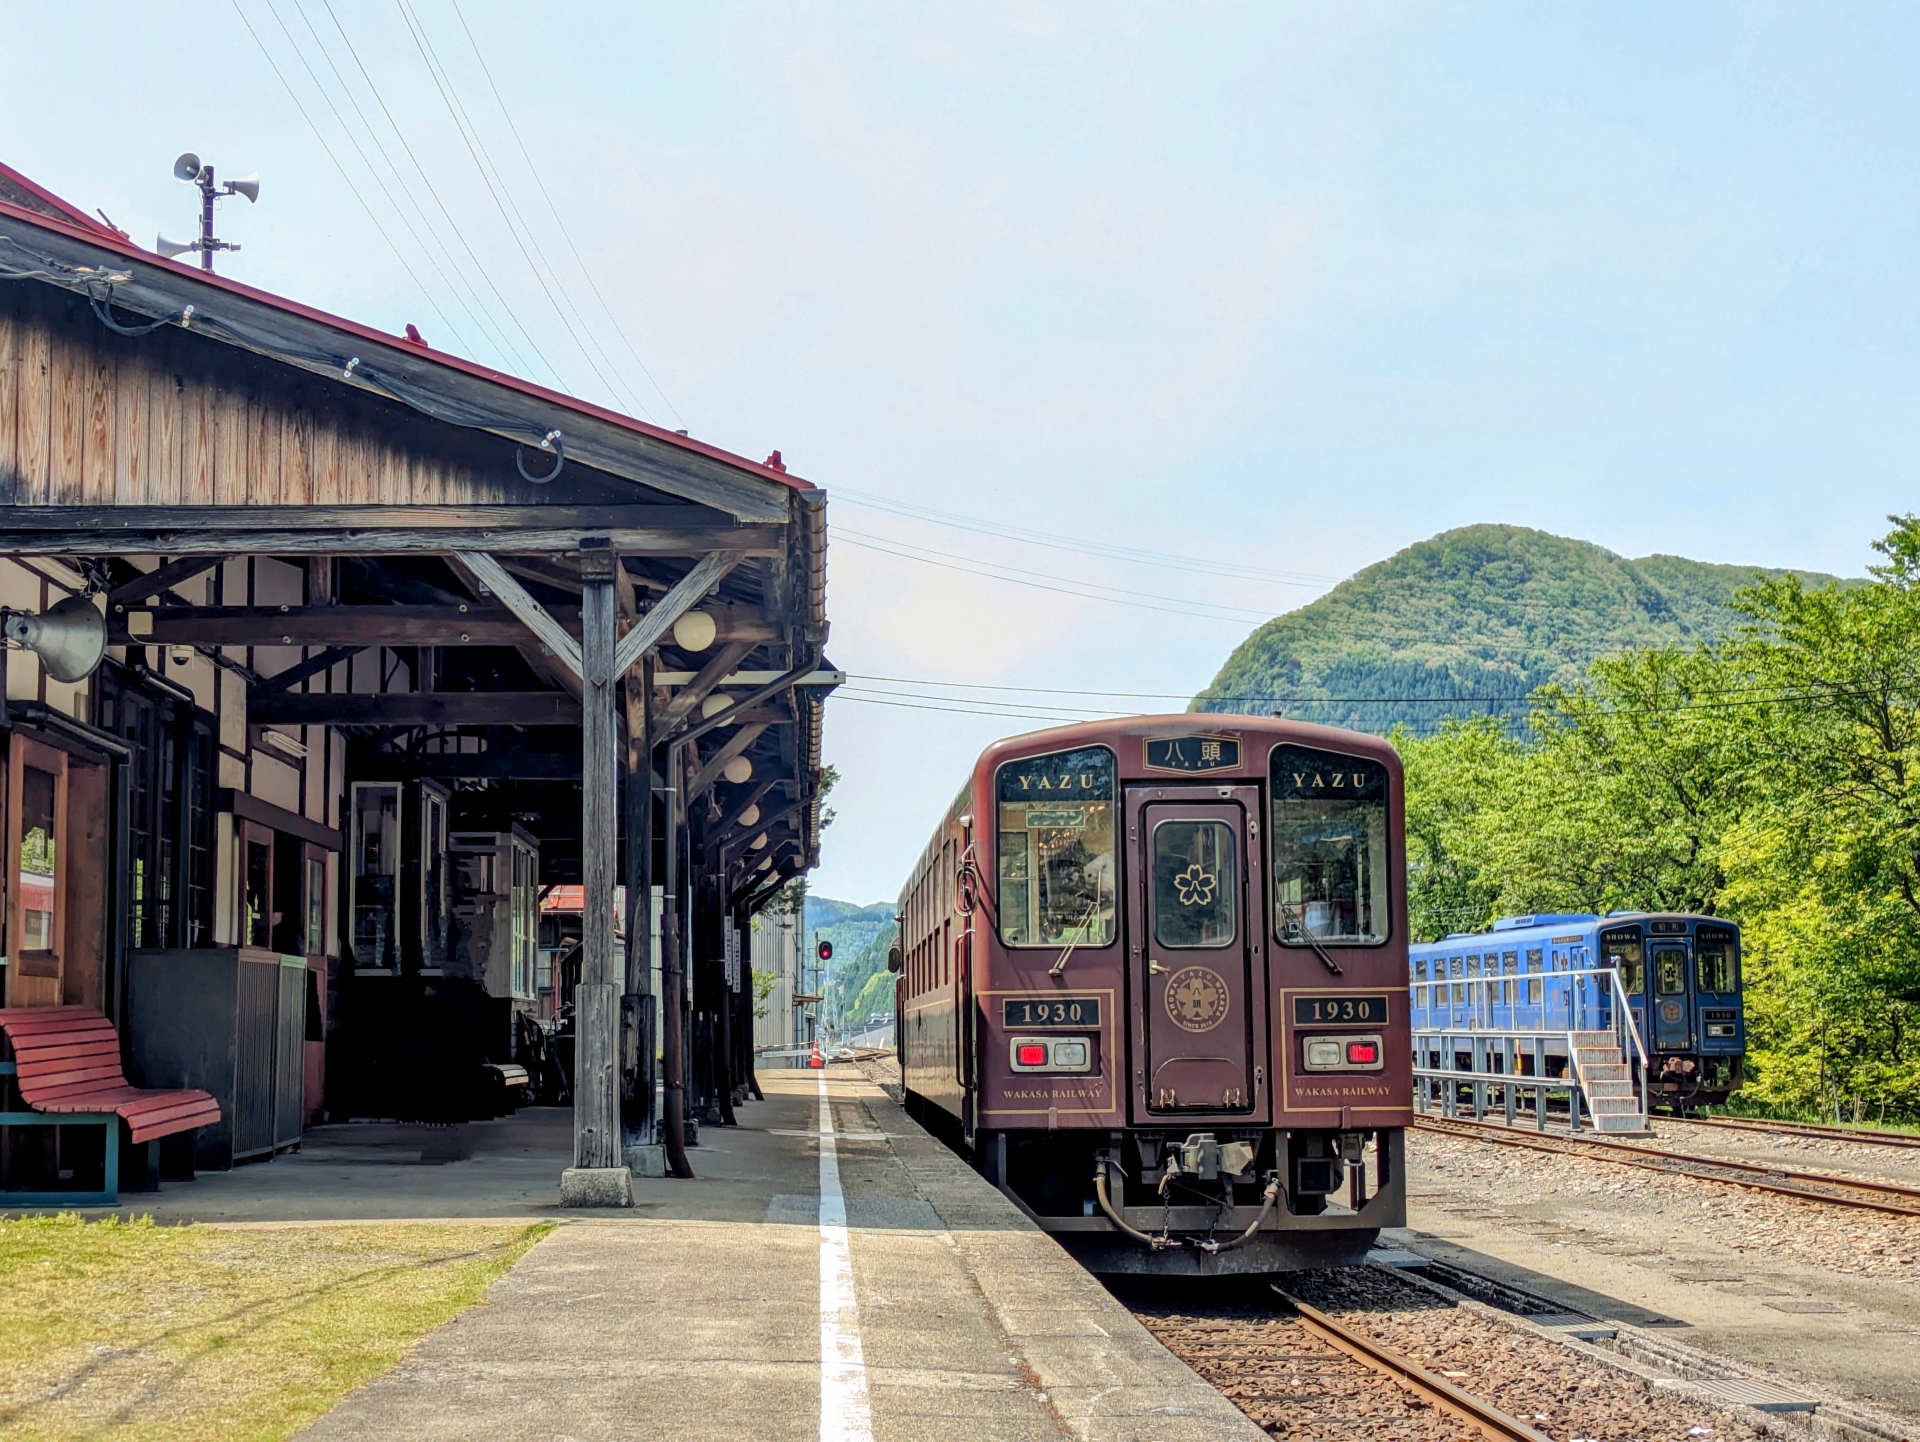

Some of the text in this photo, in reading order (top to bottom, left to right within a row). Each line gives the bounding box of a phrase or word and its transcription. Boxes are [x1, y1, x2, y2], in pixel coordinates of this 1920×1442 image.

[1164, 741, 1221, 761] 八頭
[1018, 774, 1094, 790] YAZU
[1292, 772, 1366, 788] YAZU
[1168, 970, 1226, 1017] SHOWA YAZU WAKASA
[1022, 1003, 1082, 1022] 1930
[1312, 1001, 1370, 1020] 1930
[1711, 1011, 1731, 1019] 1930
[1003, 1089, 1102, 1099] WAKASA RAILWAY
[1295, 1086, 1391, 1096] WAKASA RAILWAY
